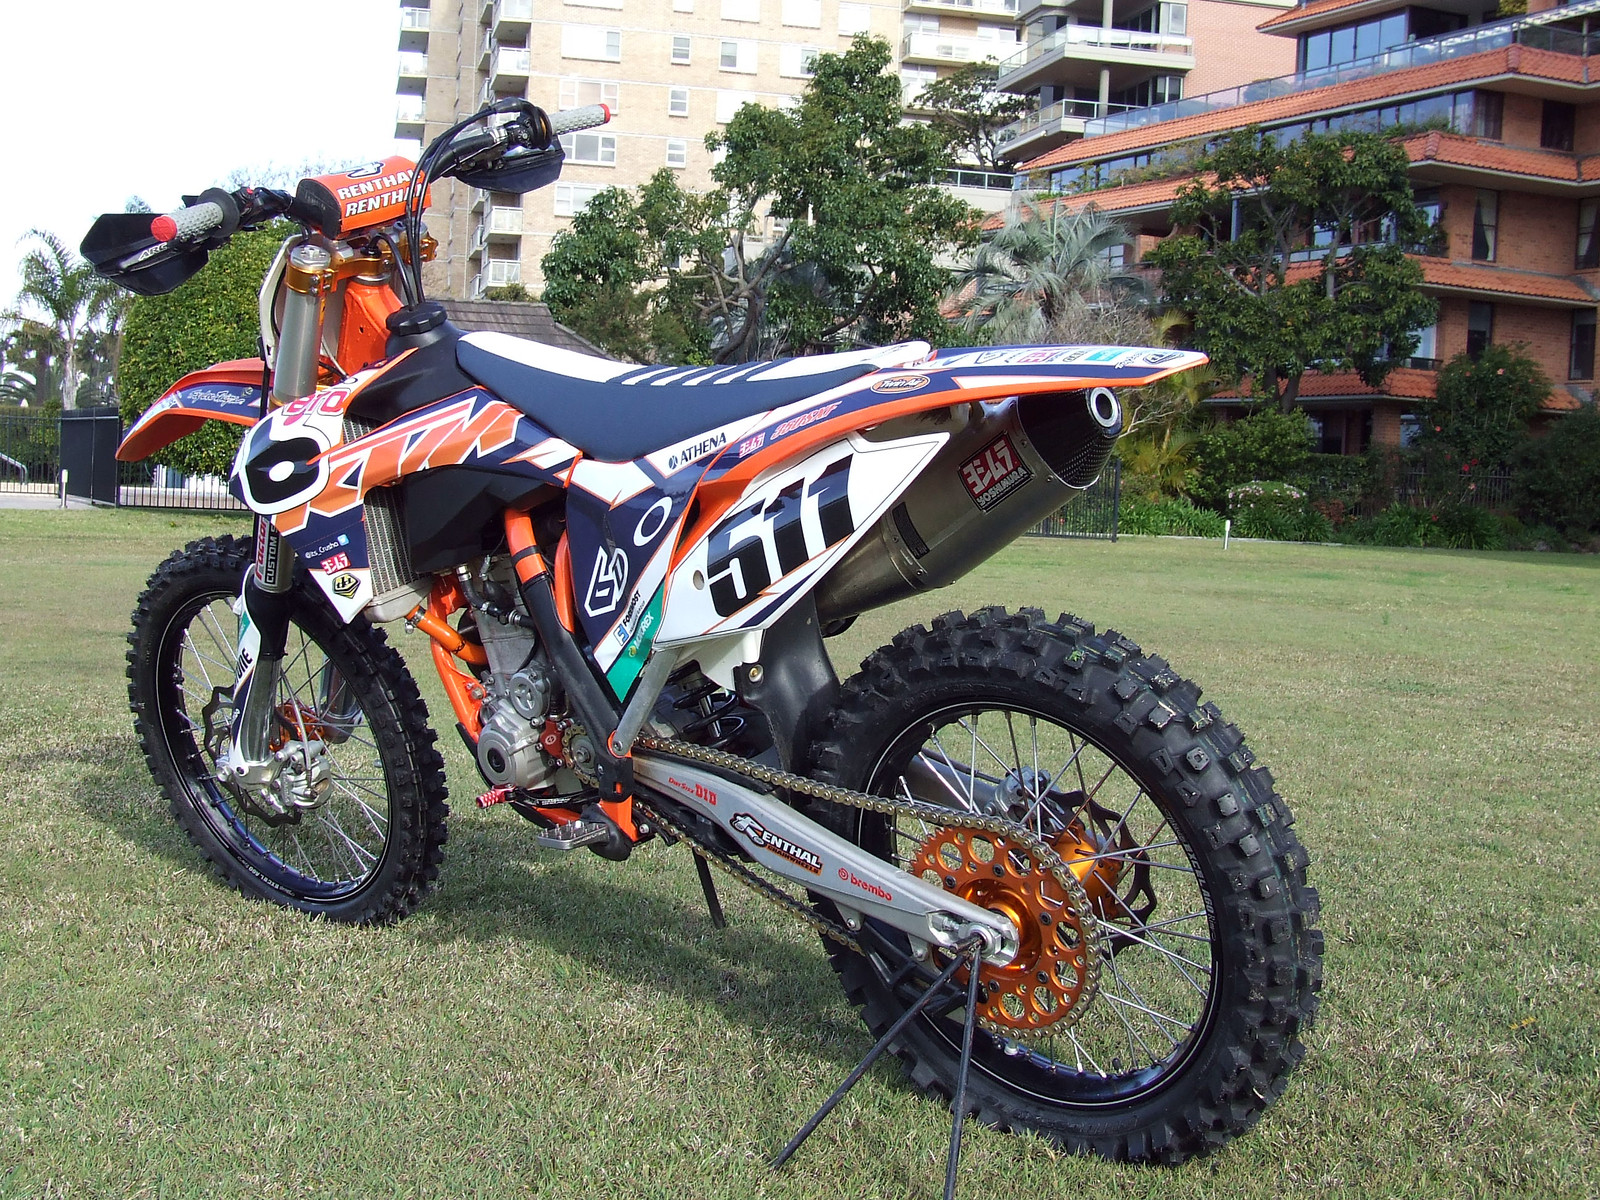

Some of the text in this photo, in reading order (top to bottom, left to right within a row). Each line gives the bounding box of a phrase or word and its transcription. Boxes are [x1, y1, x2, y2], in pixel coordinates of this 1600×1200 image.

[337, 169, 421, 200] RENTHAL
[680, 432, 727, 465] ATHENA
[976, 466, 1028, 506] YOSHIMURA
[266, 535, 278, 584] CUSTOM
[850, 873, 893, 901] brembo
